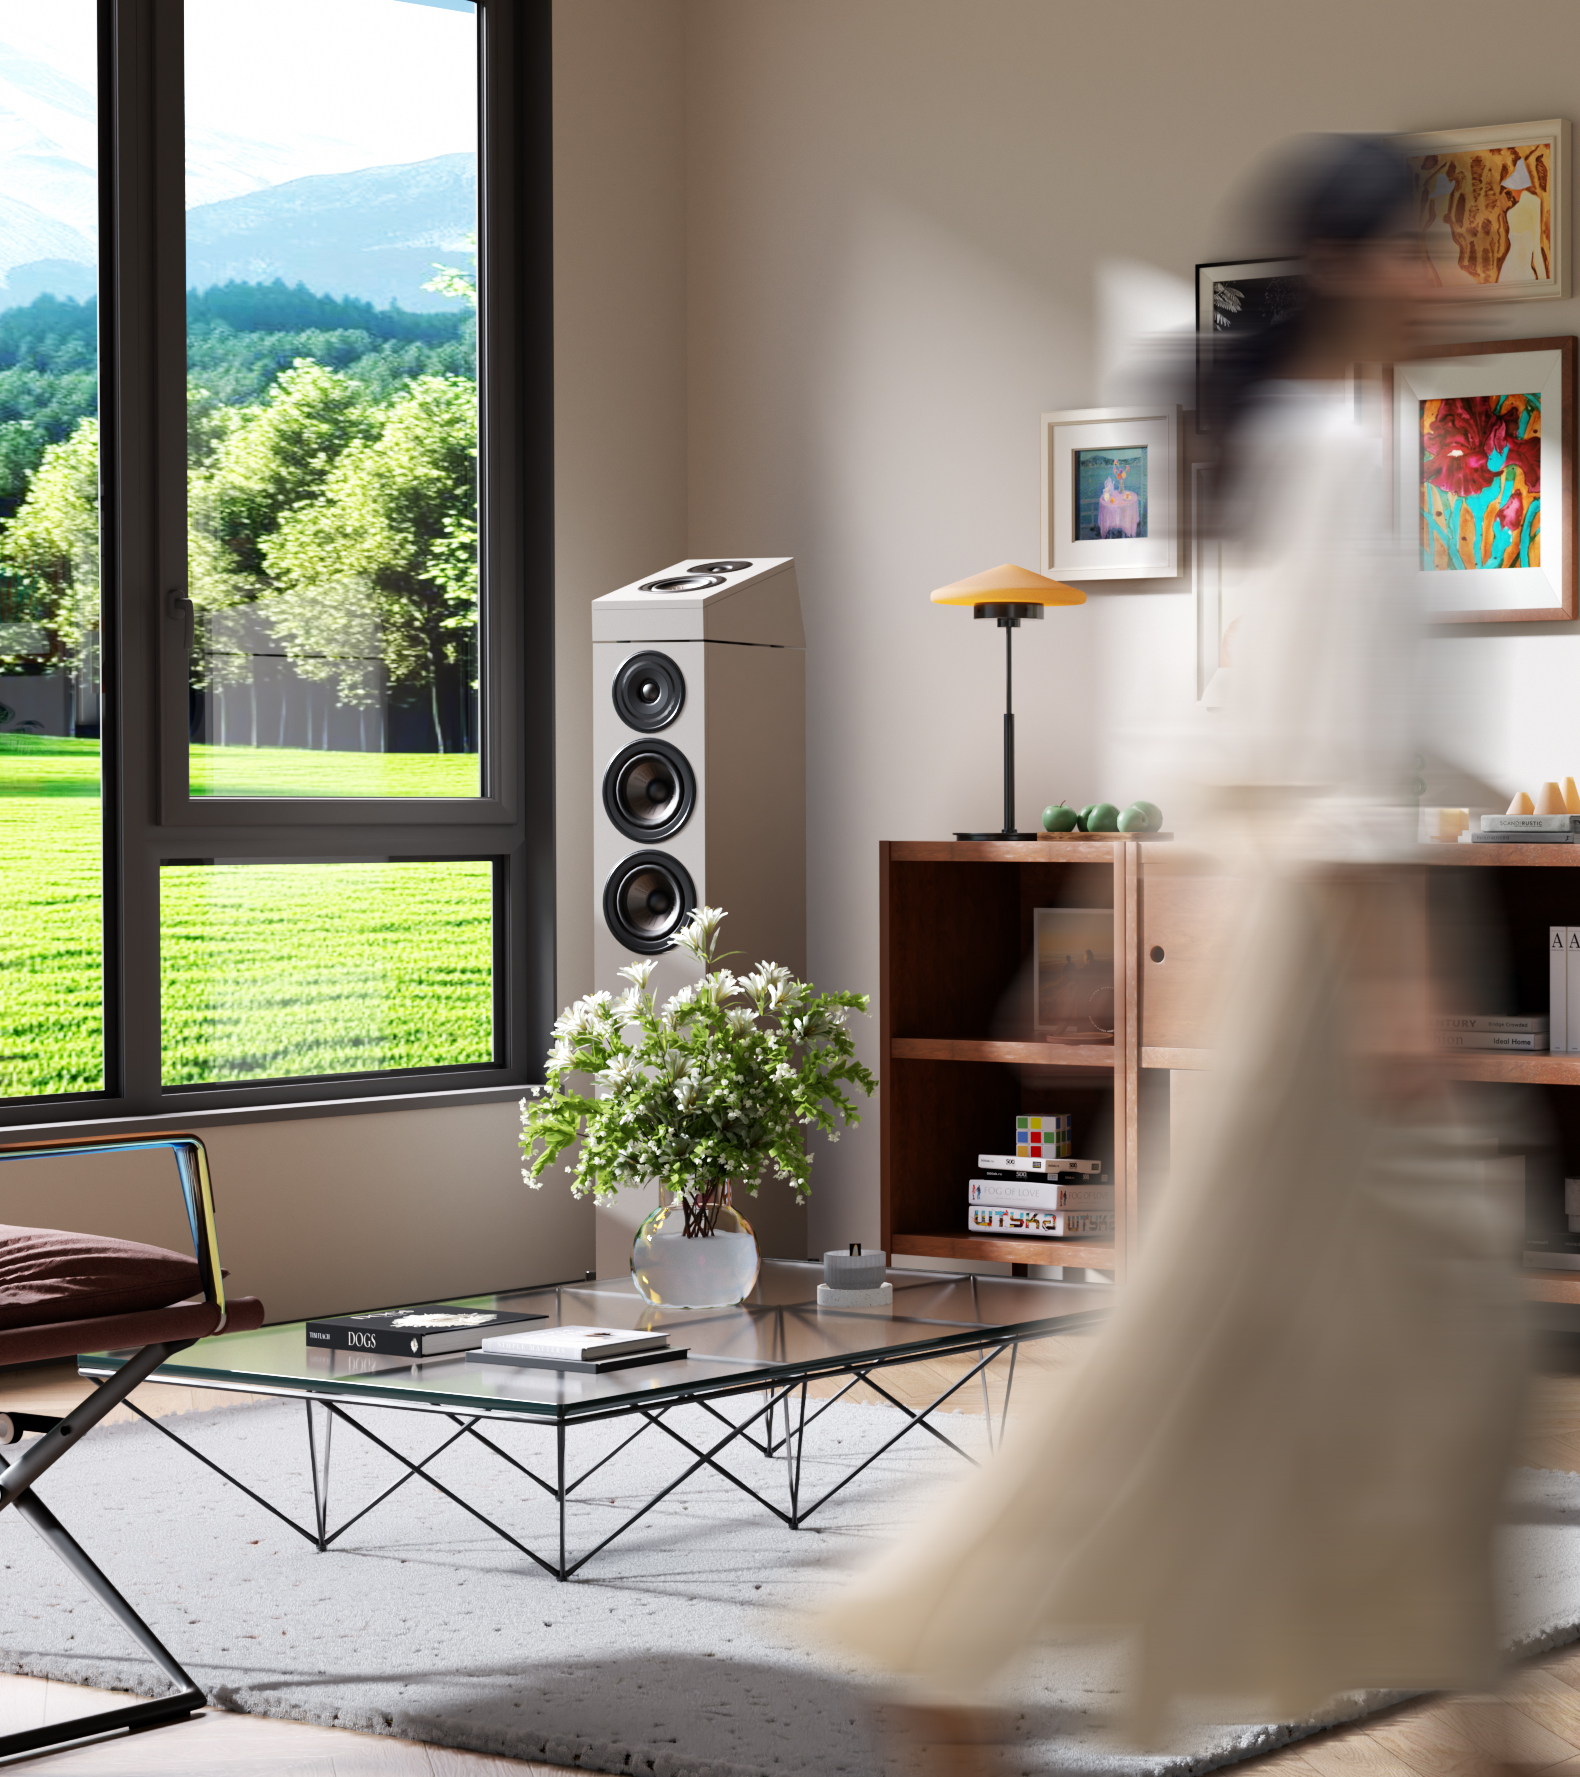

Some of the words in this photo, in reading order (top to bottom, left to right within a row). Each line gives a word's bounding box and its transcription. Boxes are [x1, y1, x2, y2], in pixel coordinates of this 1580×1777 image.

[1552, 933, 1563, 948] A
[1569, 933, 1580, 949] A
[1493, 1037, 1509, 1045] Ideal
[1511, 1038, 1531, 1046] Home
[984, 1186, 1002, 1196] FOG
[1004, 1188, 1017, 1197] OF
[1018, 1188, 1040, 1198] LOVE
[348, 1331, 376, 1349] DOGS
